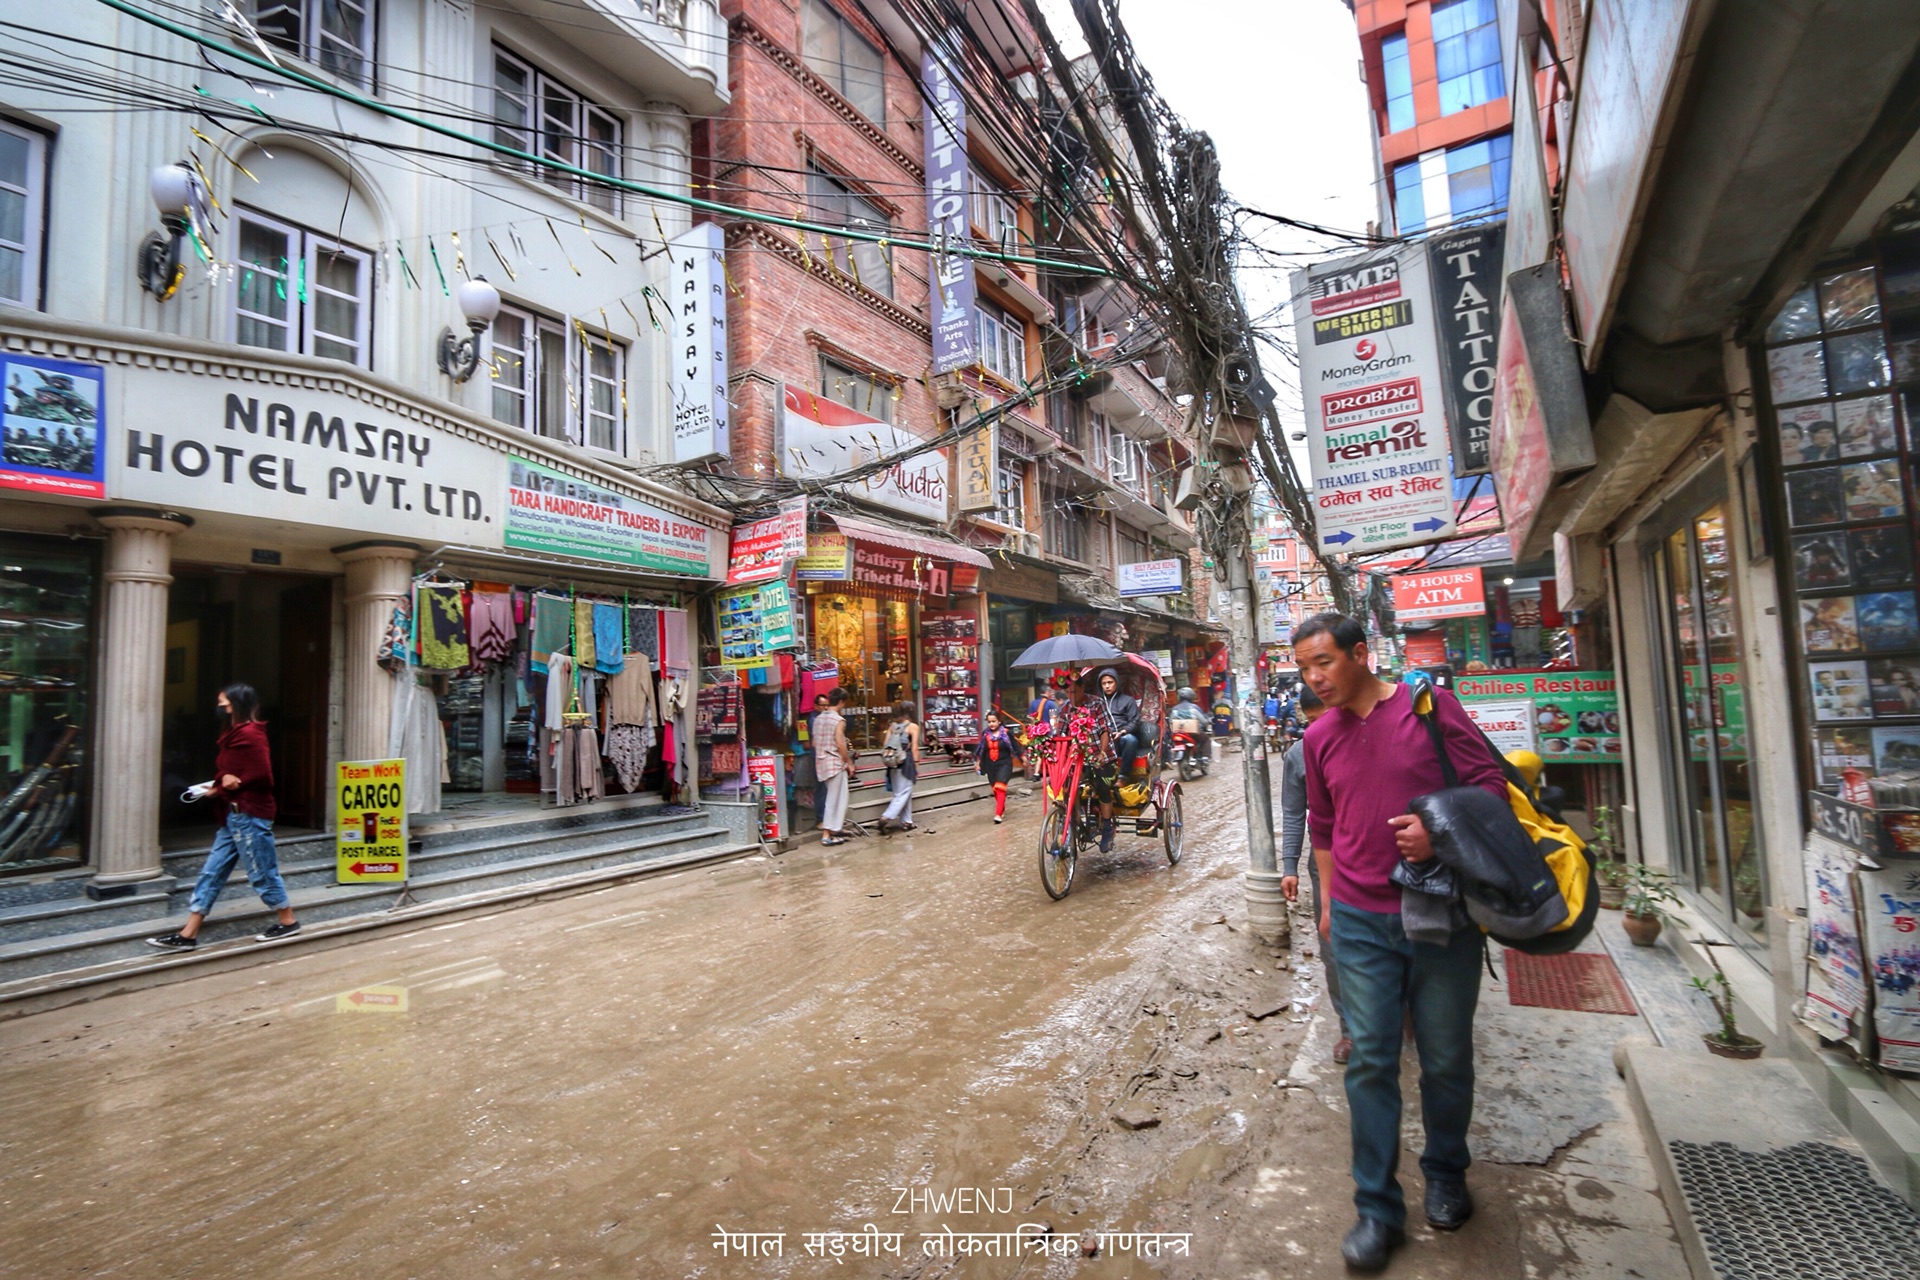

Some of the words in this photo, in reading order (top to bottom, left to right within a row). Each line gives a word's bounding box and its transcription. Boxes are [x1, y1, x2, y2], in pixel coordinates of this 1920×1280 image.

[1441, 236, 1481, 251] Gagan
[1322, 261, 1398, 297] IME
[683, 258, 698, 380] NAMSAY
[938, 320, 969, 334] Thanka
[1316, 305, 1393, 332] WESTERN
[1341, 316, 1394, 336] UNION
[712, 250, 726, 430] NAMSAY
[943, 331, 964, 342] Arts
[950, 341, 958, 349] &
[1447, 249, 1496, 422] TATTOO
[1322, 354, 1412, 381] MoneyGram
[1336, 375, 1364, 389] money
[1366, 369, 1402, 384] transfer
[676, 404, 710, 422] HOTEL
[1328, 411, 1363, 426] Money
[1369, 401, 1417, 417] Transfer
[225, 393, 430, 467] NAMSAY
[1326, 425, 1387, 449] himal
[1328, 429, 1427, 463] remit
[128, 428, 306, 495] HOTEL
[329, 467, 413, 512] PVT.
[425, 482, 491, 523] LTD.
[1317, 471, 1370, 489] THAMEL
[1372, 459, 1442, 481] SUB-REMIT
[1318, 490, 1362, 509] ठमेल
[509, 488, 541, 510] TARA
[544, 495, 613, 524] HANDICRAFT
[616, 510, 660, 533] TRADERS
[663, 520, 670, 535] &
[672, 522, 706, 542] EXPORT
[783, 523, 803, 540] HOTEL
[1362, 526, 1378, 535] 1st
[1380, 522, 1408, 532] Floor
[822, 535, 846, 547] SHIVA
[854, 567, 892, 584] Tibet
[1401, 579, 1417, 591] 24
[1420, 572, 1474, 588] HOURS
[760, 587, 788, 611] HOTEL
[1414, 587, 1463, 605] ATM
[1458, 678, 1527, 696] Chilies
[341, 765, 370, 779] Team
[373, 763, 401, 778] Work
[342, 783, 402, 810] CARGO
[380, 816, 401, 825] FedEx
[341, 847, 365, 858] POST
[367, 846, 402, 857] PARCEL
[364, 864, 395, 873] Inside
